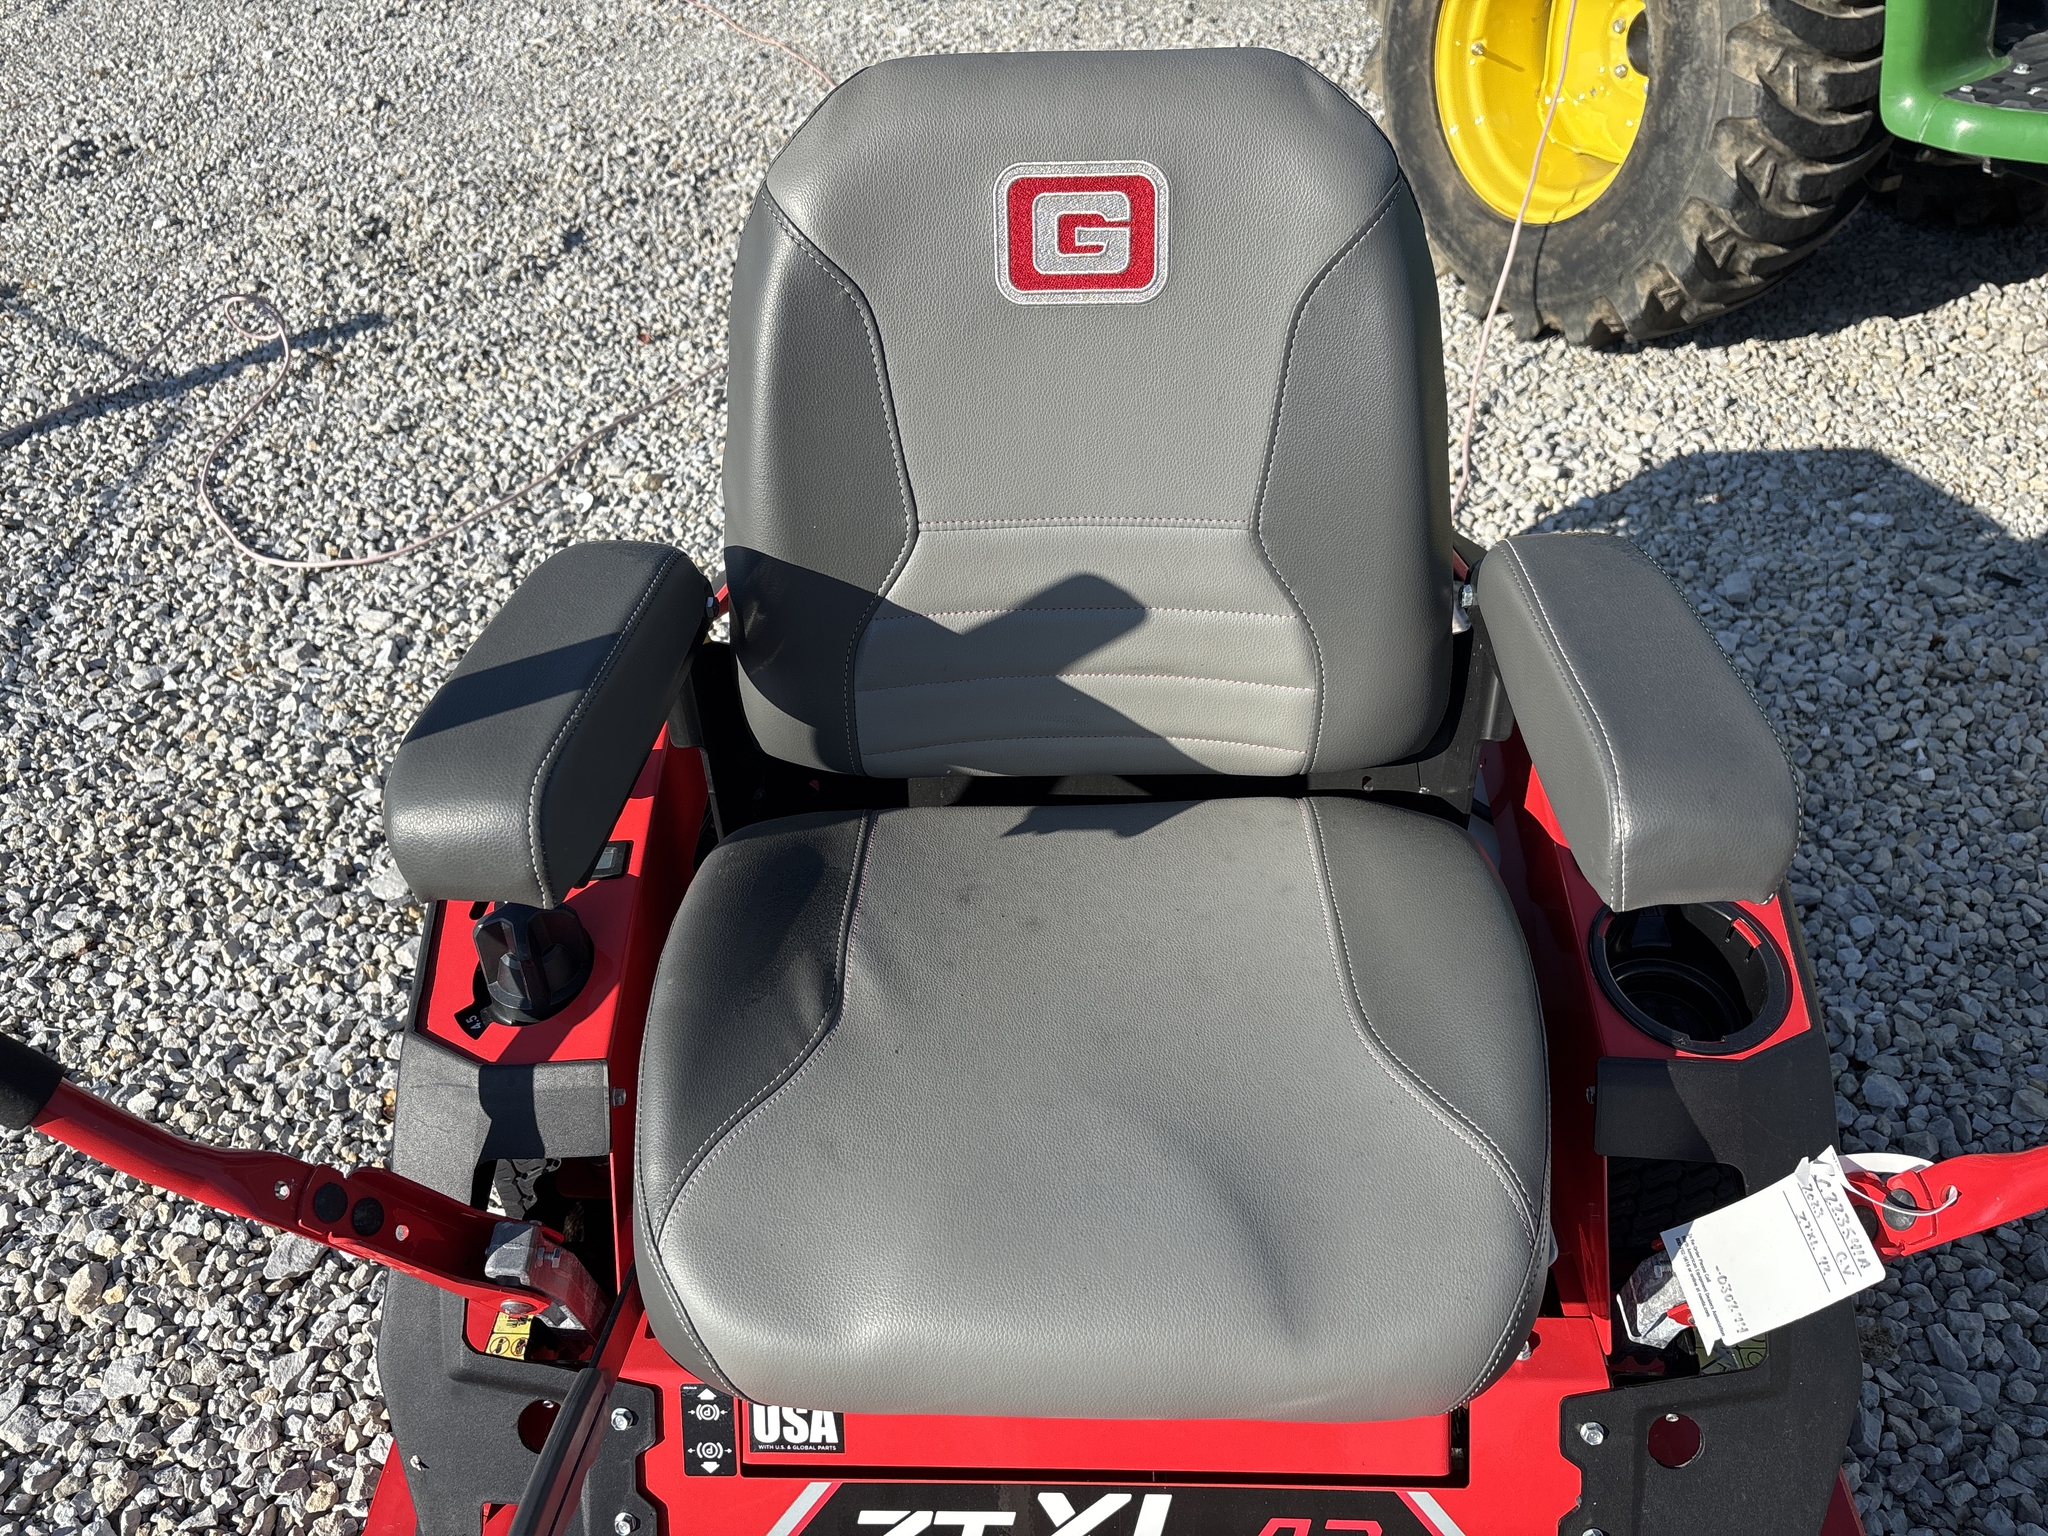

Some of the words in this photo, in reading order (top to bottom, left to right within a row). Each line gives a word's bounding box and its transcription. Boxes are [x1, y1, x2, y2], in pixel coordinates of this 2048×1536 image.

[466, 1015, 482, 1030] 4.5
[1686, 1247, 1698, 1269] American
[1694, 1268, 1708, 1293] Equipment
[1704, 1292, 1715, 1310] Dealers
[1711, 1310, 1726, 1337] Association
[752, 1404, 839, 1444] USA
